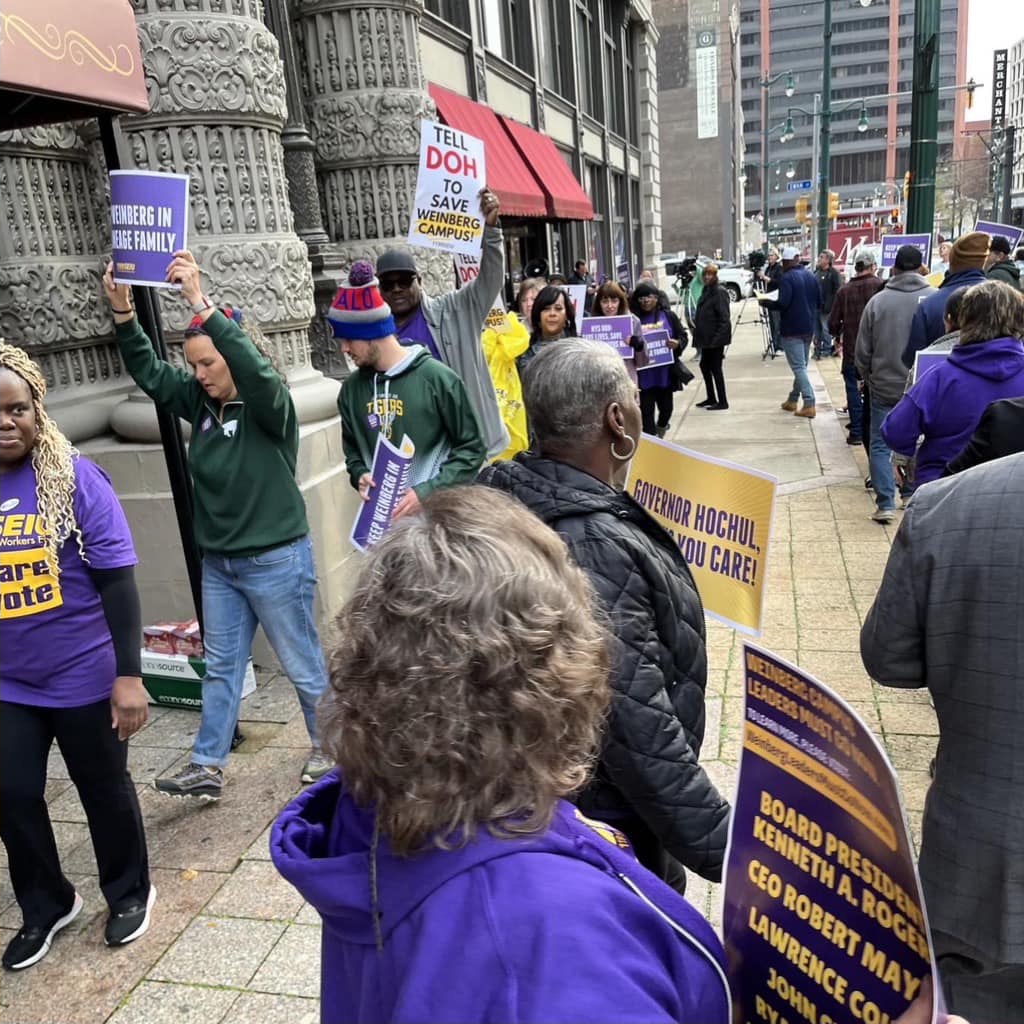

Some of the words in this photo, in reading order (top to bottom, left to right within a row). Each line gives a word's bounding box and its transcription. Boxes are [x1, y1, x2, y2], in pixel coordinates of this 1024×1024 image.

[434, 126, 468, 151] TELL
[426, 145, 477, 179] DOH
[430, 194, 469, 213] SAVE
[443, 178, 463, 195] TO
[157, 206, 172, 228] IN
[417, 207, 480, 230] WEINBERG
[418, 222, 475, 243] CAMPUS!
[134, 231, 176, 253] FAMILY
[458, 253, 478, 265] TELL
[372, 473, 398, 523] WEINBERG
[385, 460, 401, 476] IN
[633, 478, 692, 528] GOVERNOR
[693, 504, 761, 555] HOCHUL,
[709, 545, 758, 587] CARE!
[759, 790, 823, 848] BOARD
[753, 815, 836, 889] KENNETH
[837, 874, 859, 907] A.
[748, 860, 783, 899] CEO
[782, 884, 862, 957] ROBERT
[748, 906, 849, 1004] LAWRENCE
[766, 967, 817, 1024] JOHN
